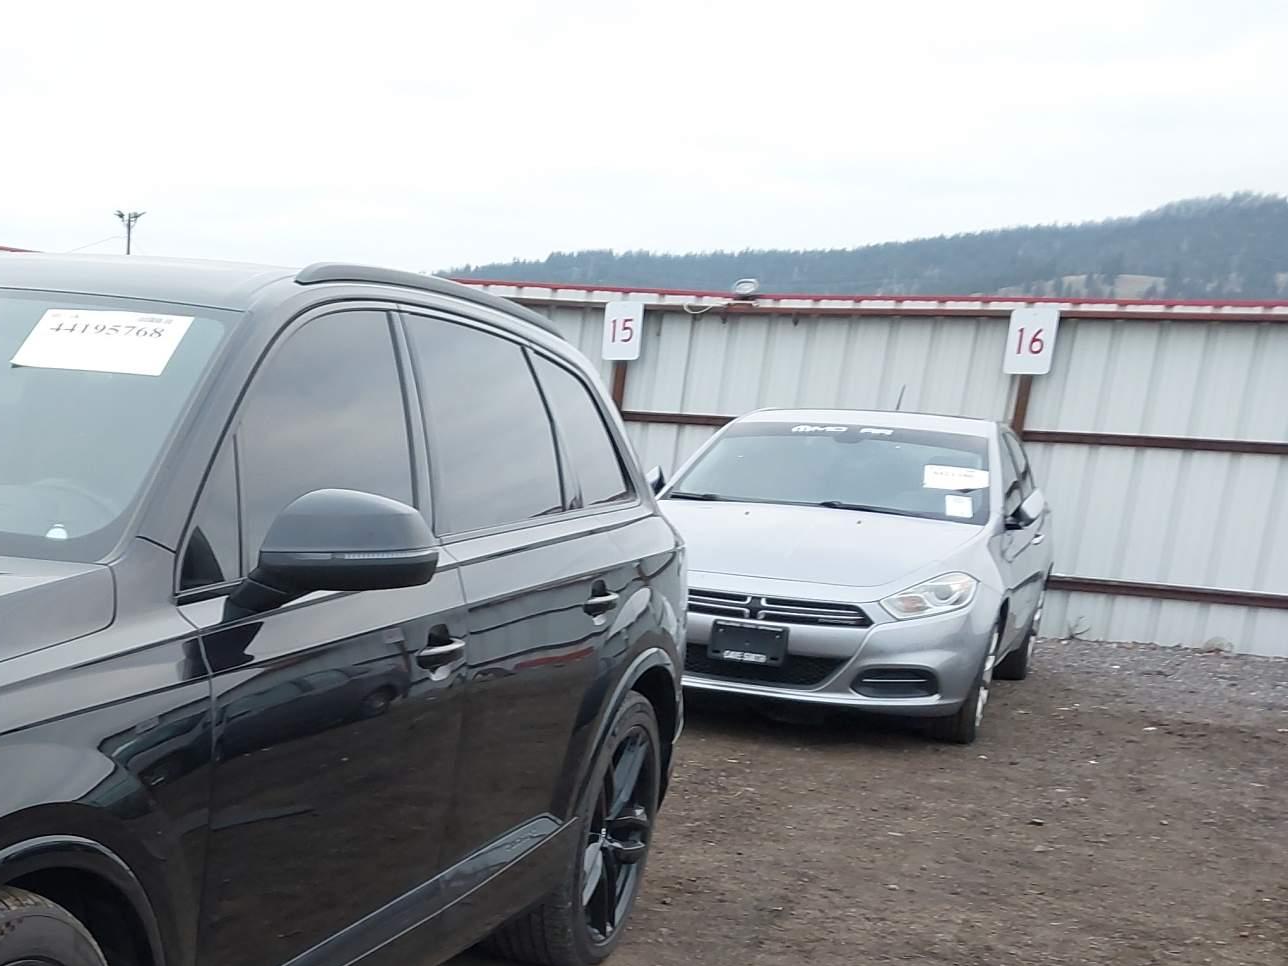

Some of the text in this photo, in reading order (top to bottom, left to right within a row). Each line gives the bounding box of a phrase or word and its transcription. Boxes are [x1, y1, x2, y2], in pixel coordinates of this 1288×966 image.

[50, 322, 165, 338] 44195768
[611, 318, 634, 343] 15
[1016, 327, 1044, 355] 16
